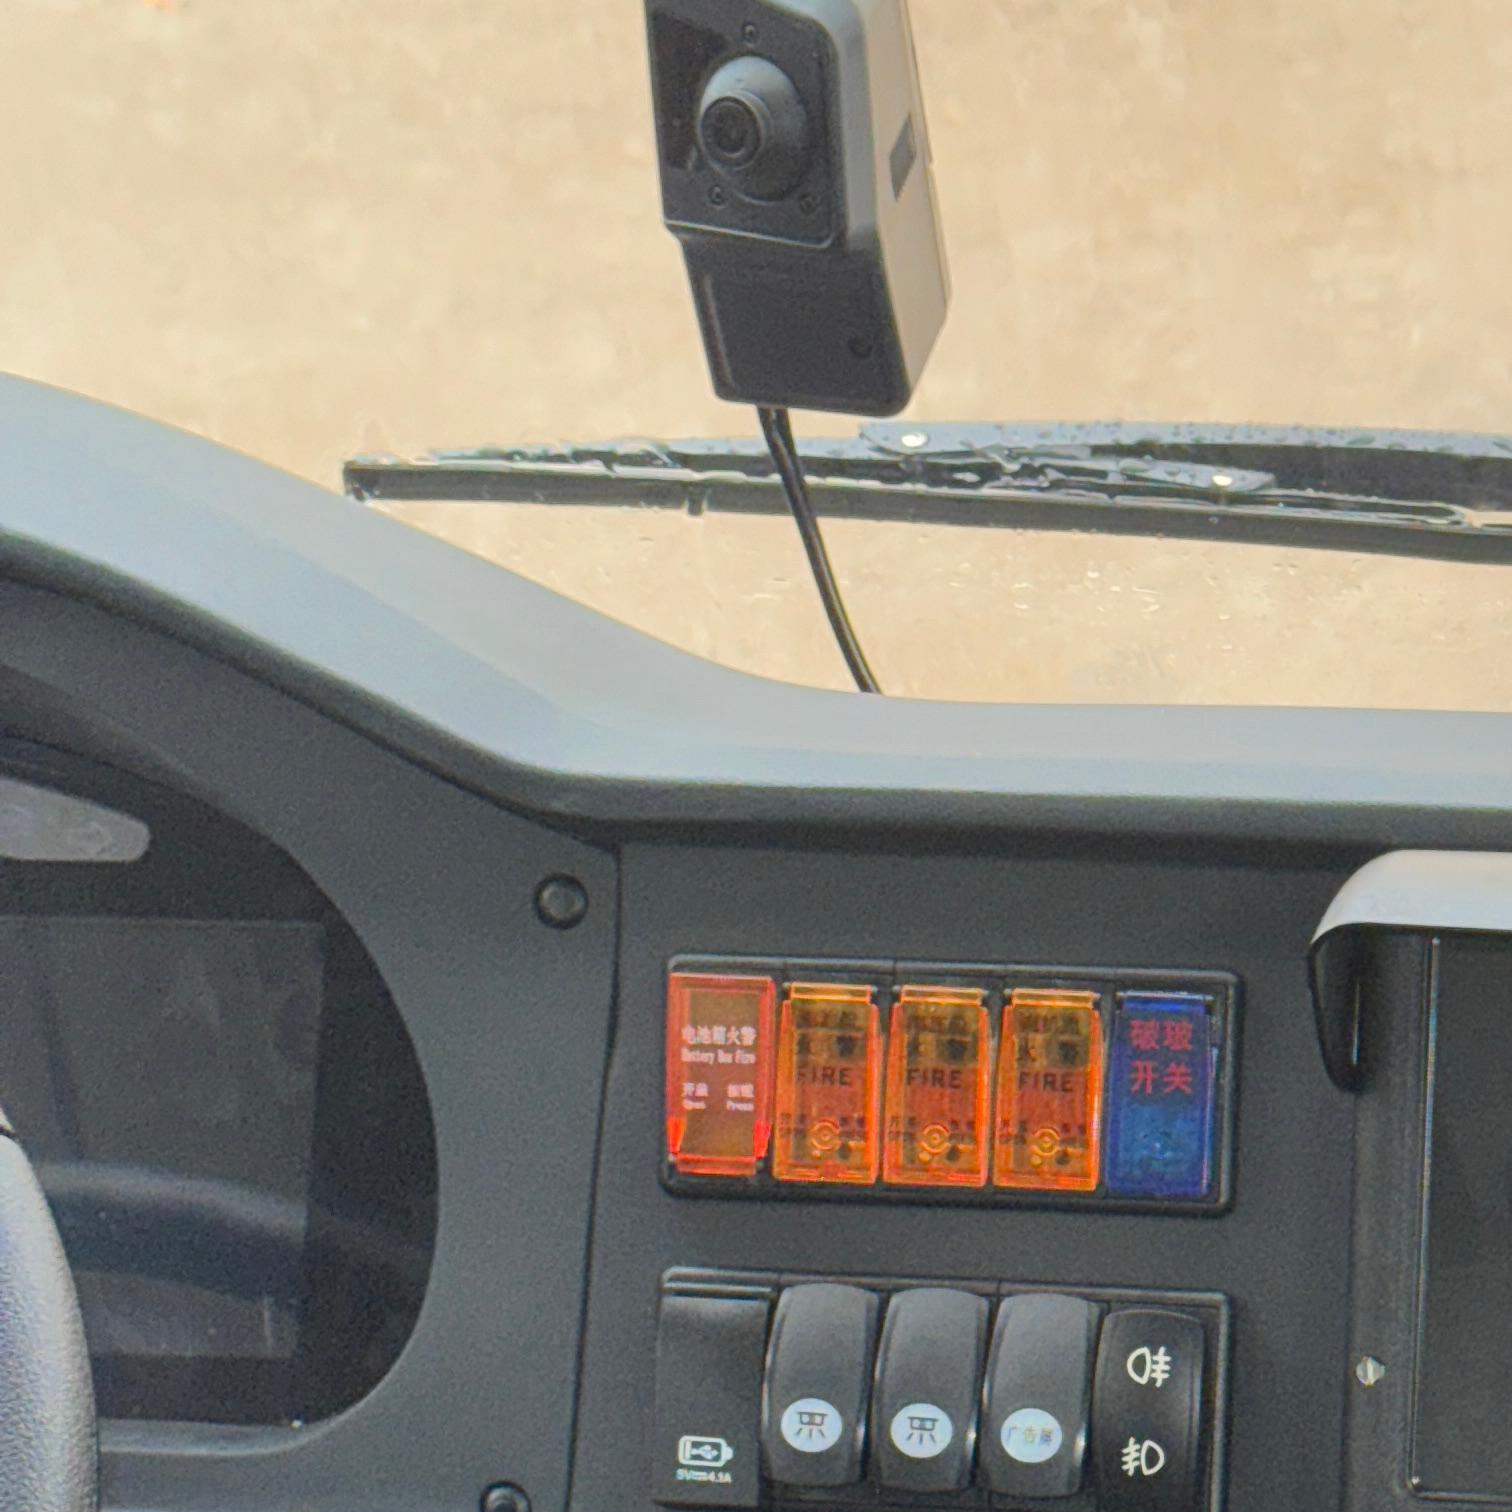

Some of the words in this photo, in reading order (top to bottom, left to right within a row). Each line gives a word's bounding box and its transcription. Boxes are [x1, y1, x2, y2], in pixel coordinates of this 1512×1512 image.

[797, 1067, 853, 1087] FIRE
[907, 1067, 963, 1088] FIRE
[1018, 1071, 1074, 1093] FIRE
[1129, 1060, 1193, 1095] 开关
